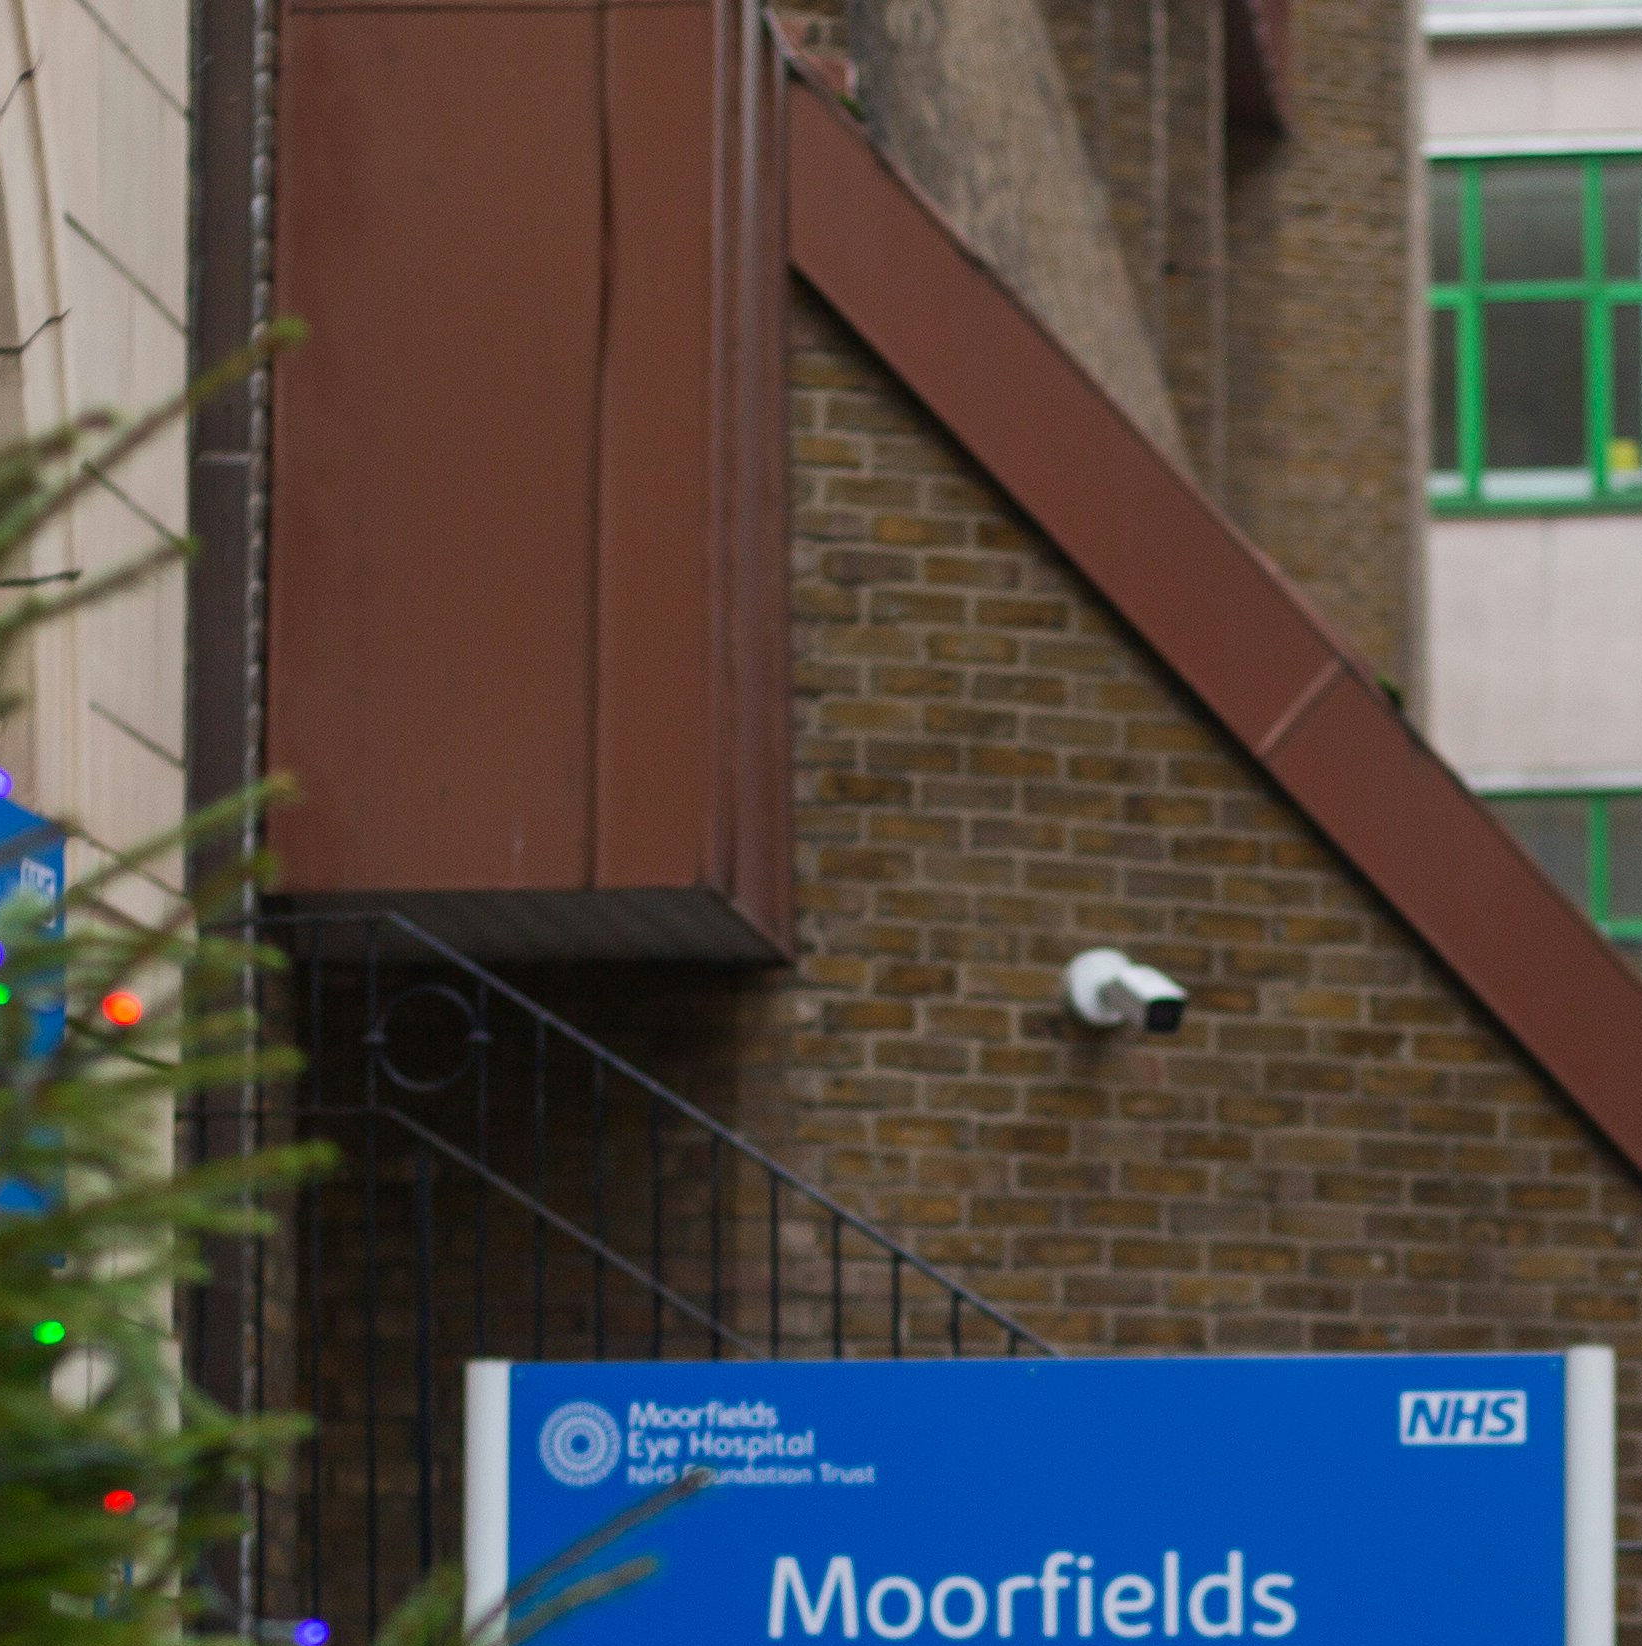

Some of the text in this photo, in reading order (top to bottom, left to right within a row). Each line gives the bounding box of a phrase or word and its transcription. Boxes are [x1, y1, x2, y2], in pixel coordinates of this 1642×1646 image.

[628, 1400, 778, 1428] Moorfields
[1407, 1397, 1517, 1437] NHS
[628, 1430, 814, 1465] Eye Hospital
[768, 1550, 1297, 1639] Moorfields
